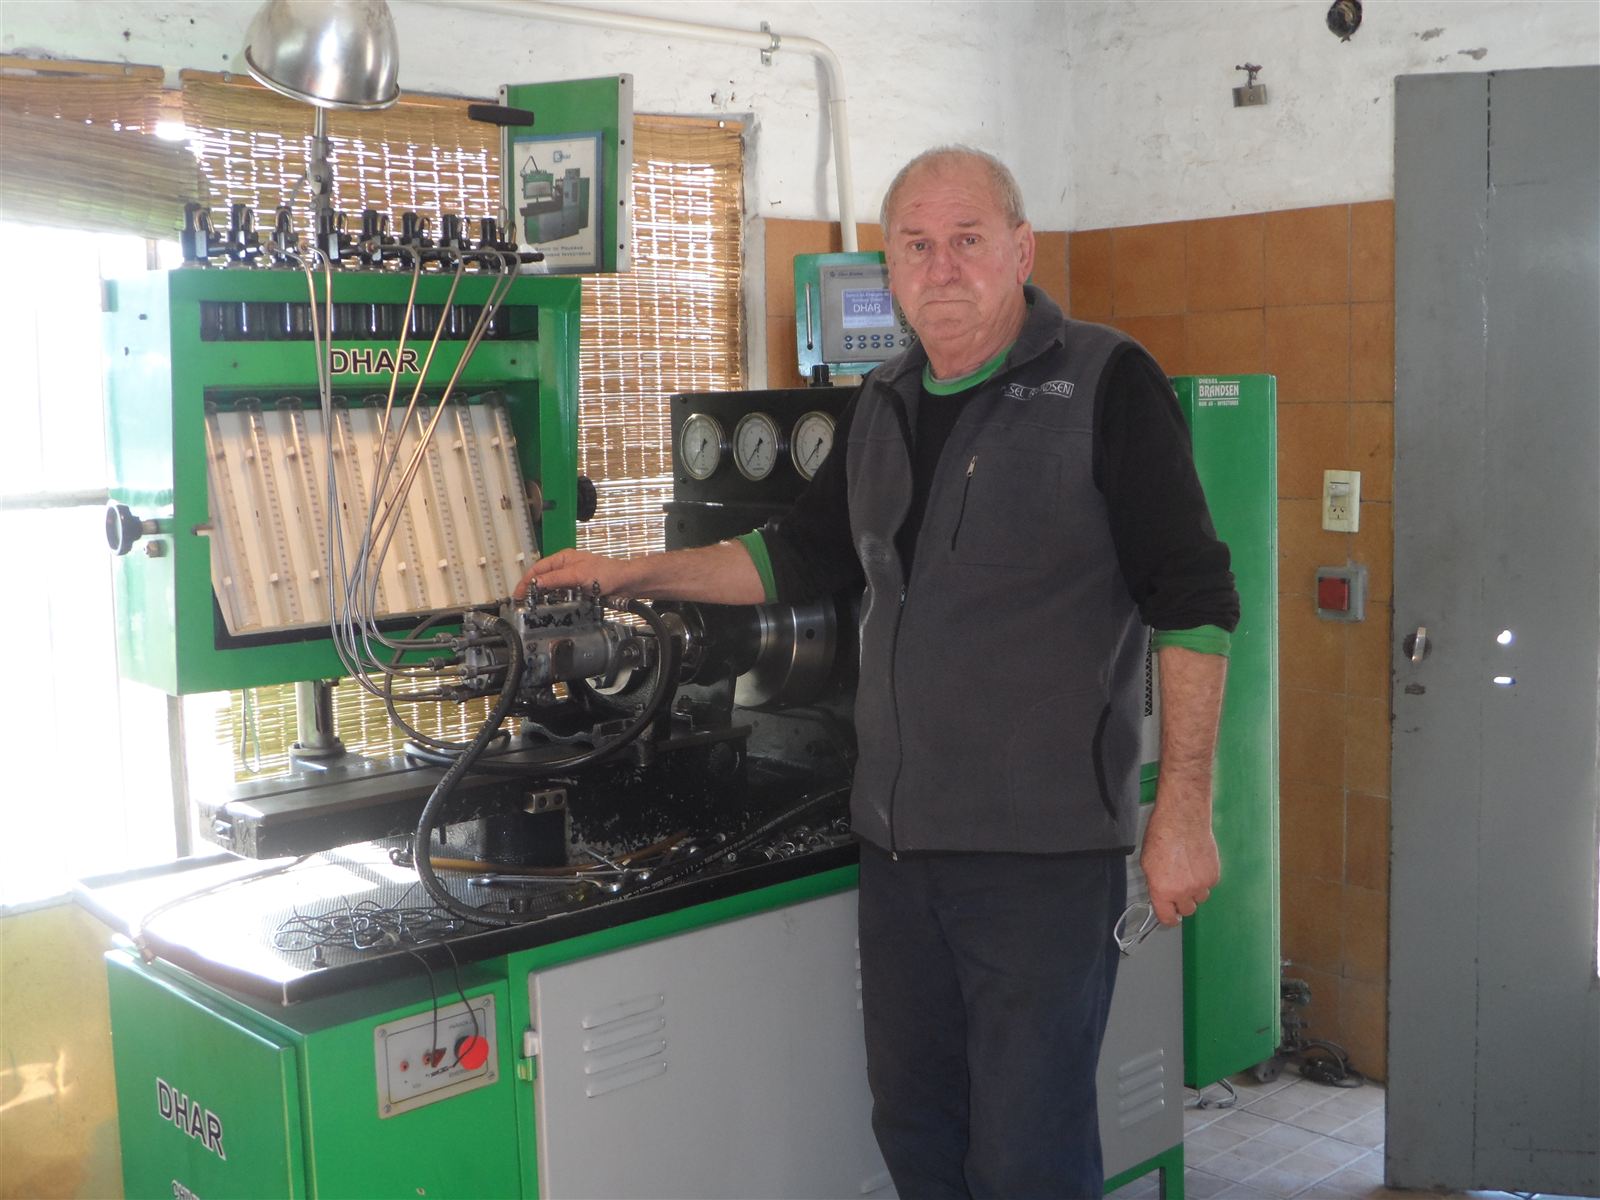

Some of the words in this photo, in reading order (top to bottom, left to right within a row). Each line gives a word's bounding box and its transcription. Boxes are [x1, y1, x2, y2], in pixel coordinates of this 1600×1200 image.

[330, 348, 420, 374] DHAR
[1199, 384, 1239, 397] BRANDSEN
[156, 1077, 226, 1160] DHAR
